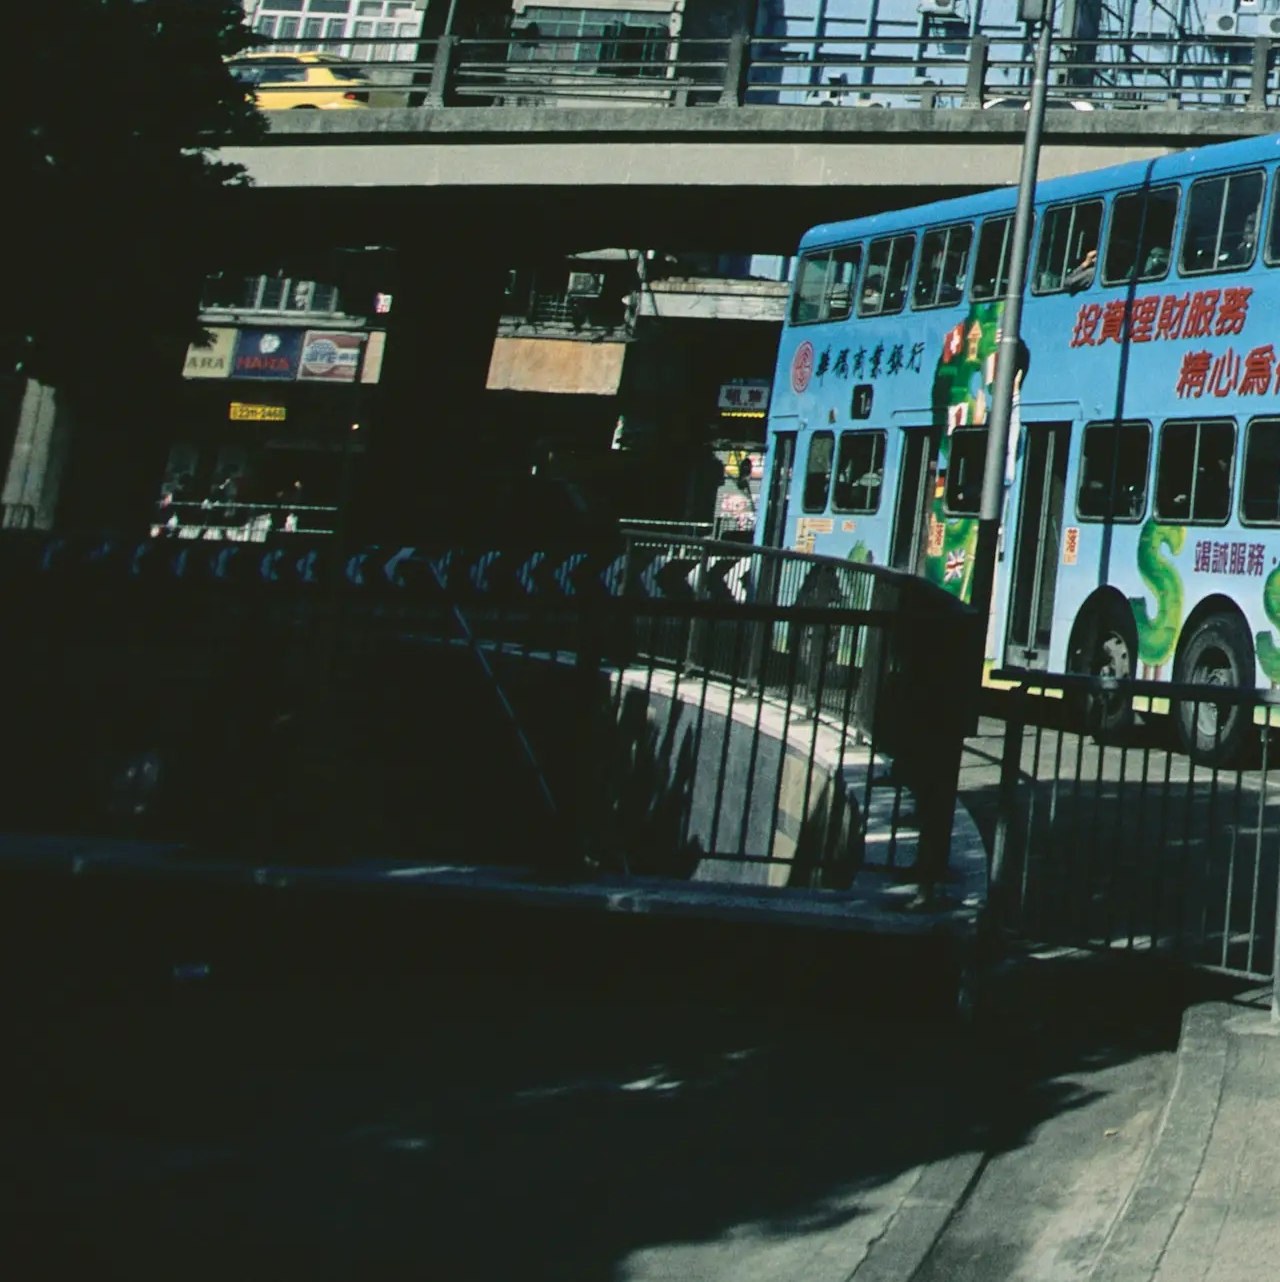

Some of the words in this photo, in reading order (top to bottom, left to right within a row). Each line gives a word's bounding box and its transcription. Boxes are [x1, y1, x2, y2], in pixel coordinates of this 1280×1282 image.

[1070, 286, 1253, 348] 投資理財服務
